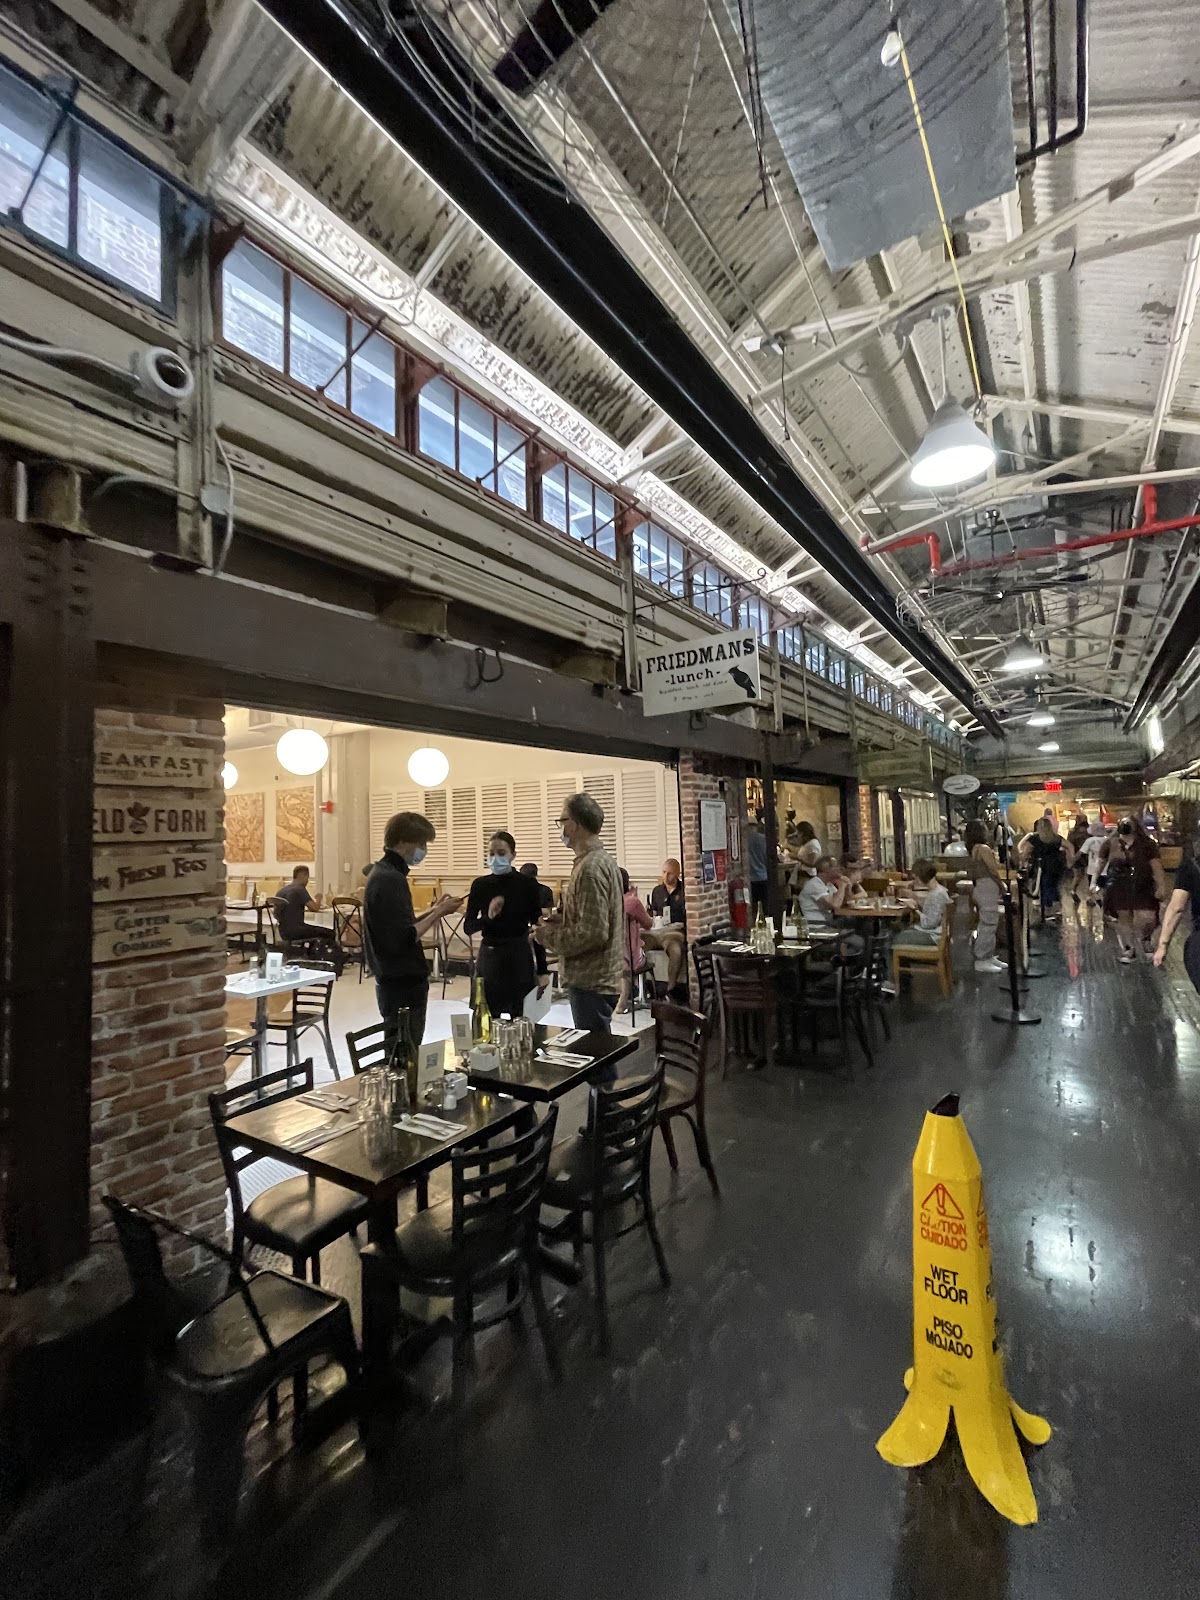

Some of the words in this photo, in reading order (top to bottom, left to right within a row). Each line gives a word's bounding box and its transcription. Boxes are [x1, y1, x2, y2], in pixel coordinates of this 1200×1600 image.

[646, 637, 755, 674] FRIEDMANS
[920, 1227, 968, 1251] CUIDADO
[930, 1263, 958, 1286] WET
[924, 1276, 968, 1305] FLOOR
[933, 1315, 963, 1340] PISO
[925, 1327, 973, 1359] MOJADO
